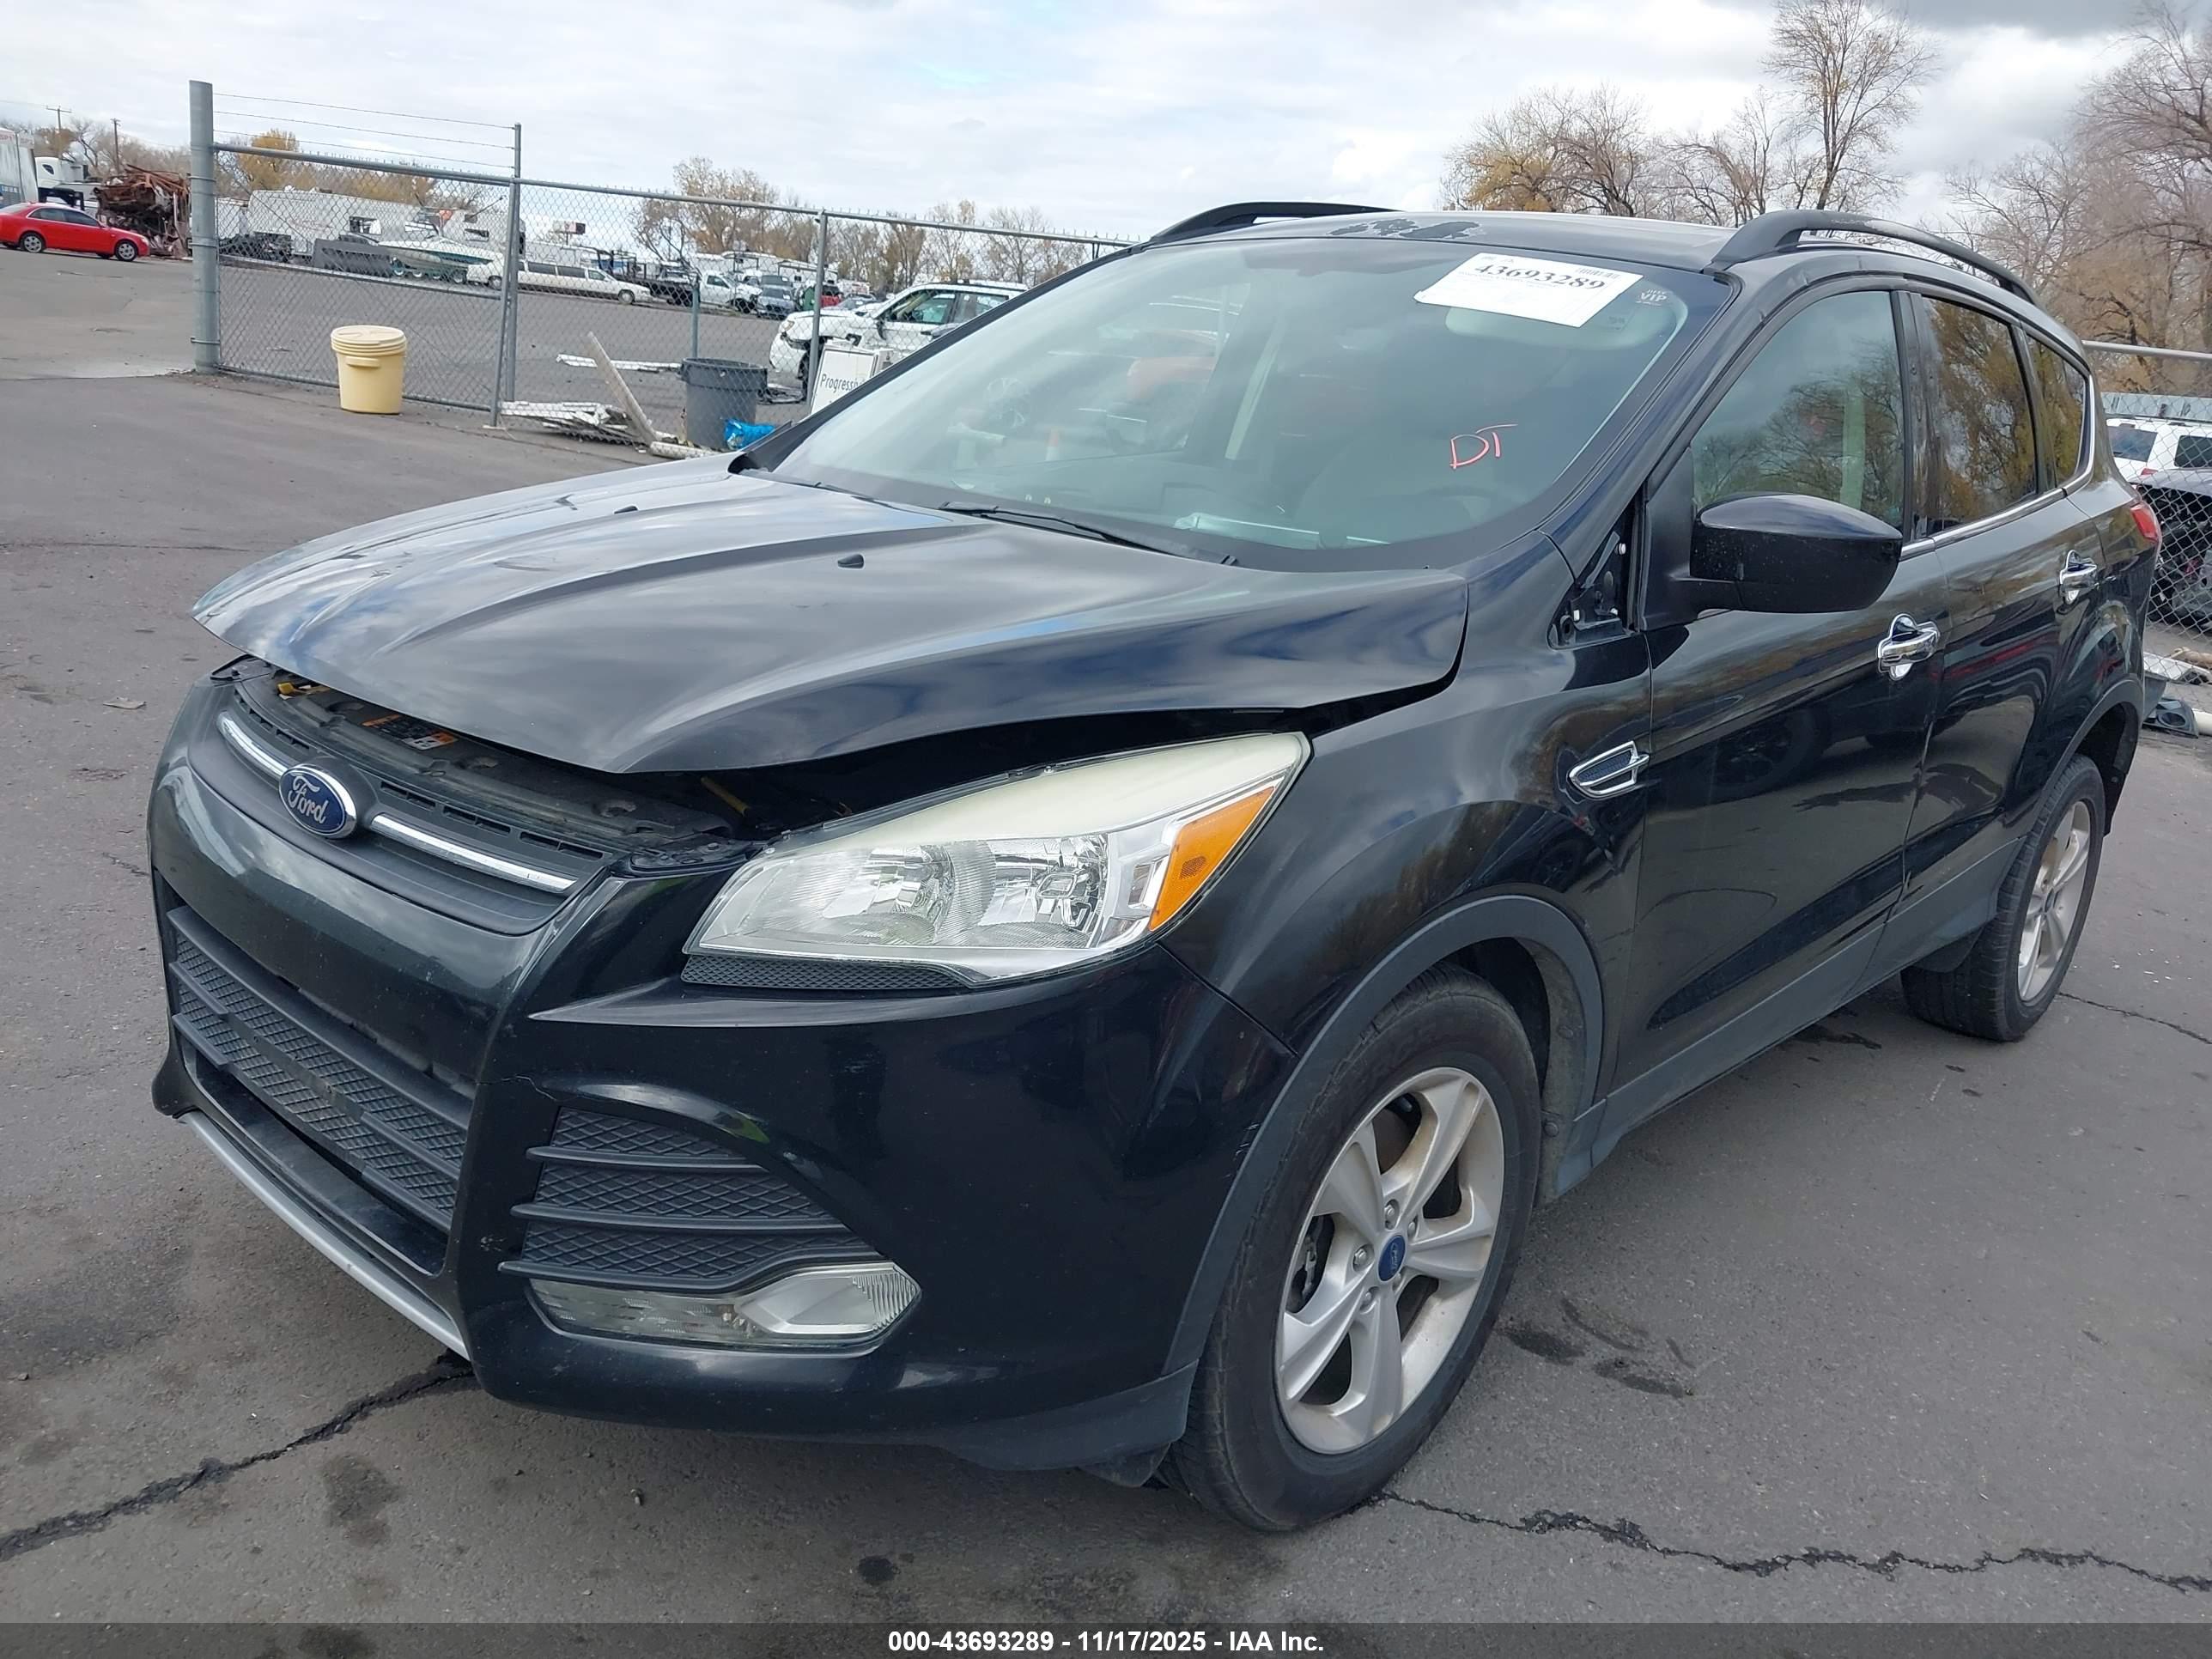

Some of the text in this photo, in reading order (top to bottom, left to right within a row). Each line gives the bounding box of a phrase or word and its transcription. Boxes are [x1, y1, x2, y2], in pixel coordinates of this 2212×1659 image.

[1474, 264, 1606, 289] 43693289
[1449, 423, 1518, 470] DT
[288, 773, 329, 824] Ford
